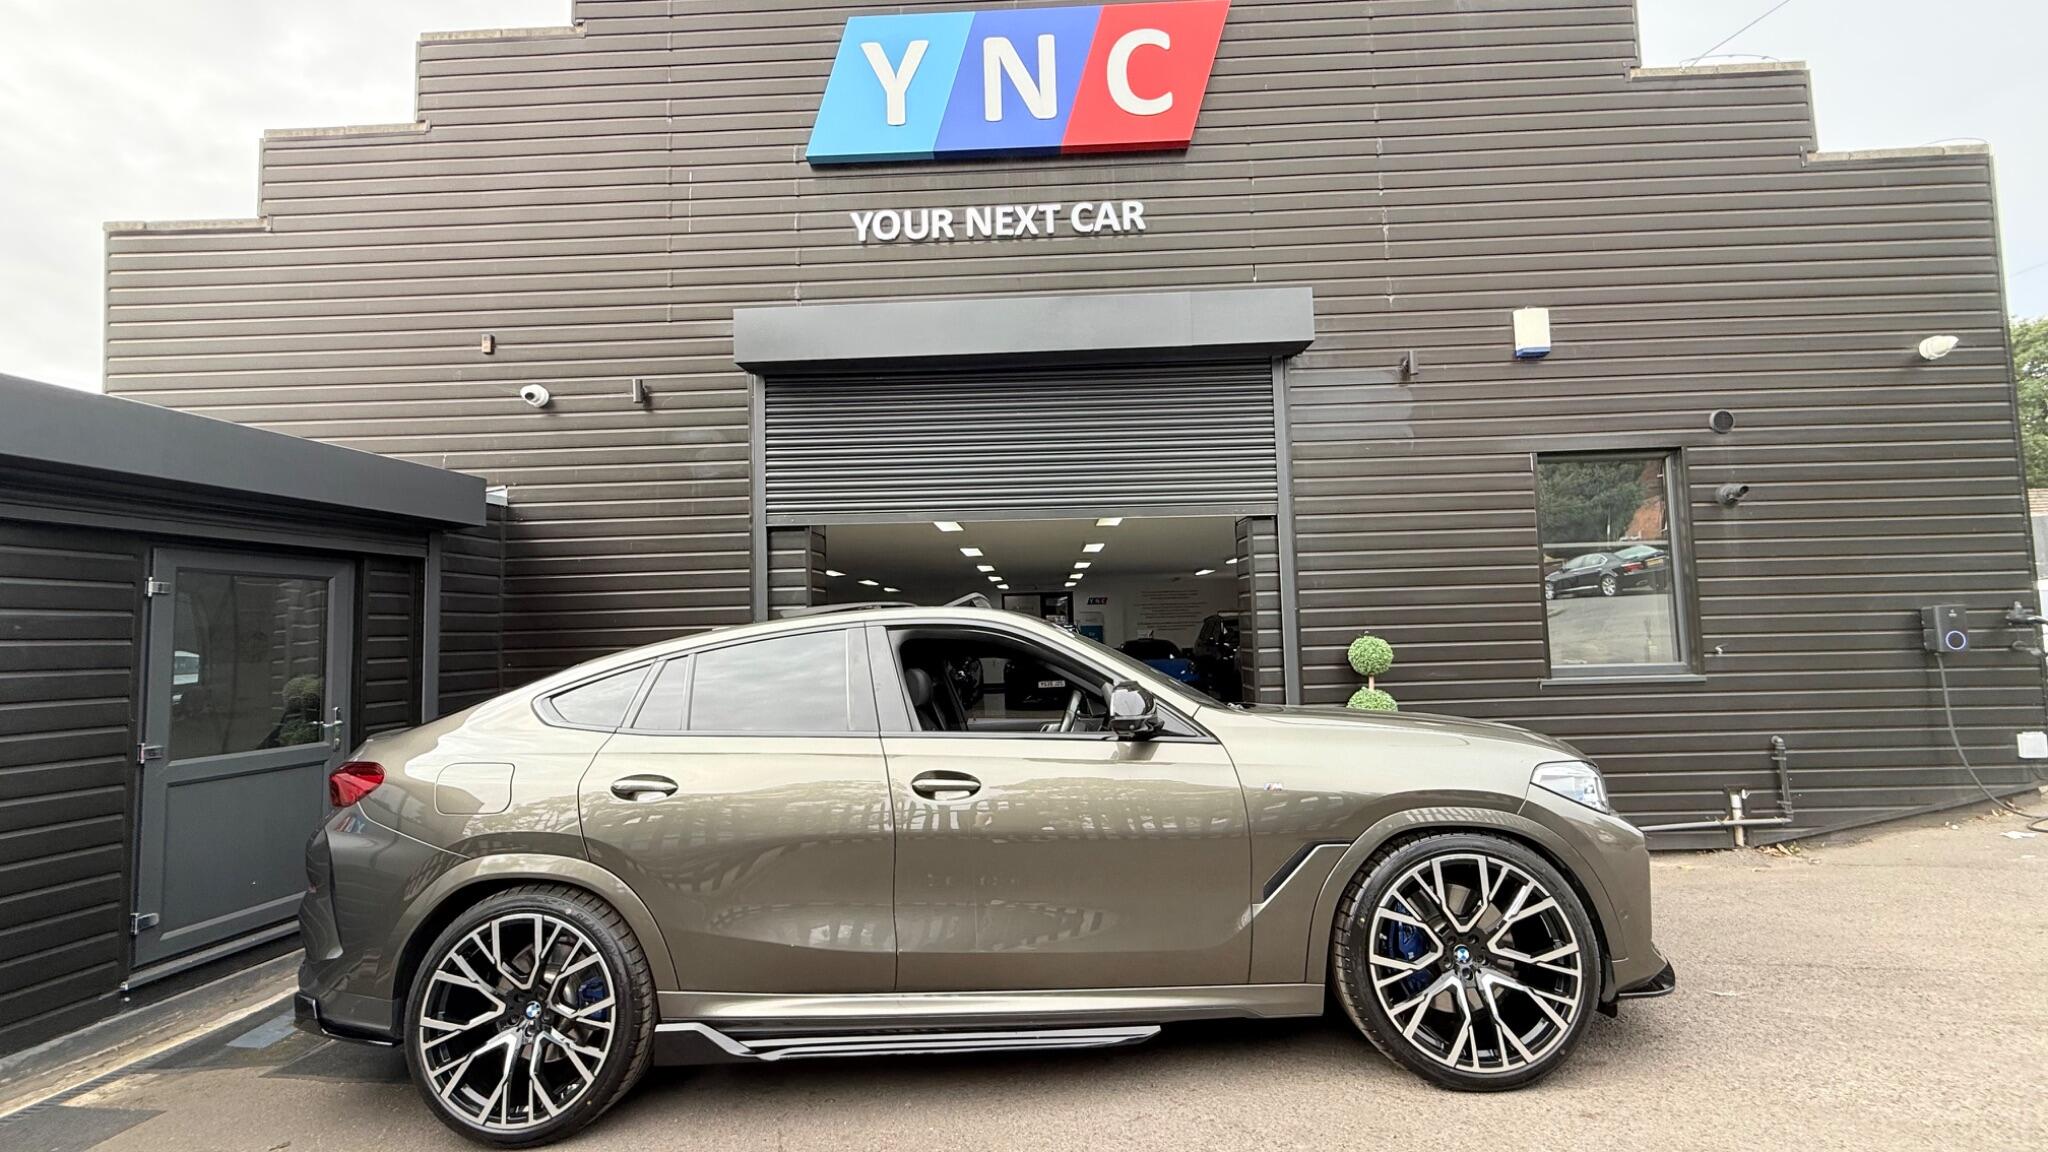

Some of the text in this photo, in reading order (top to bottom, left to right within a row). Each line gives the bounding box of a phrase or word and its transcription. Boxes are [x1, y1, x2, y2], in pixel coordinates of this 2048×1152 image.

[860, 28, 1173, 126] YNC
[850, 199, 1146, 242] YOUR NEXT CAR
